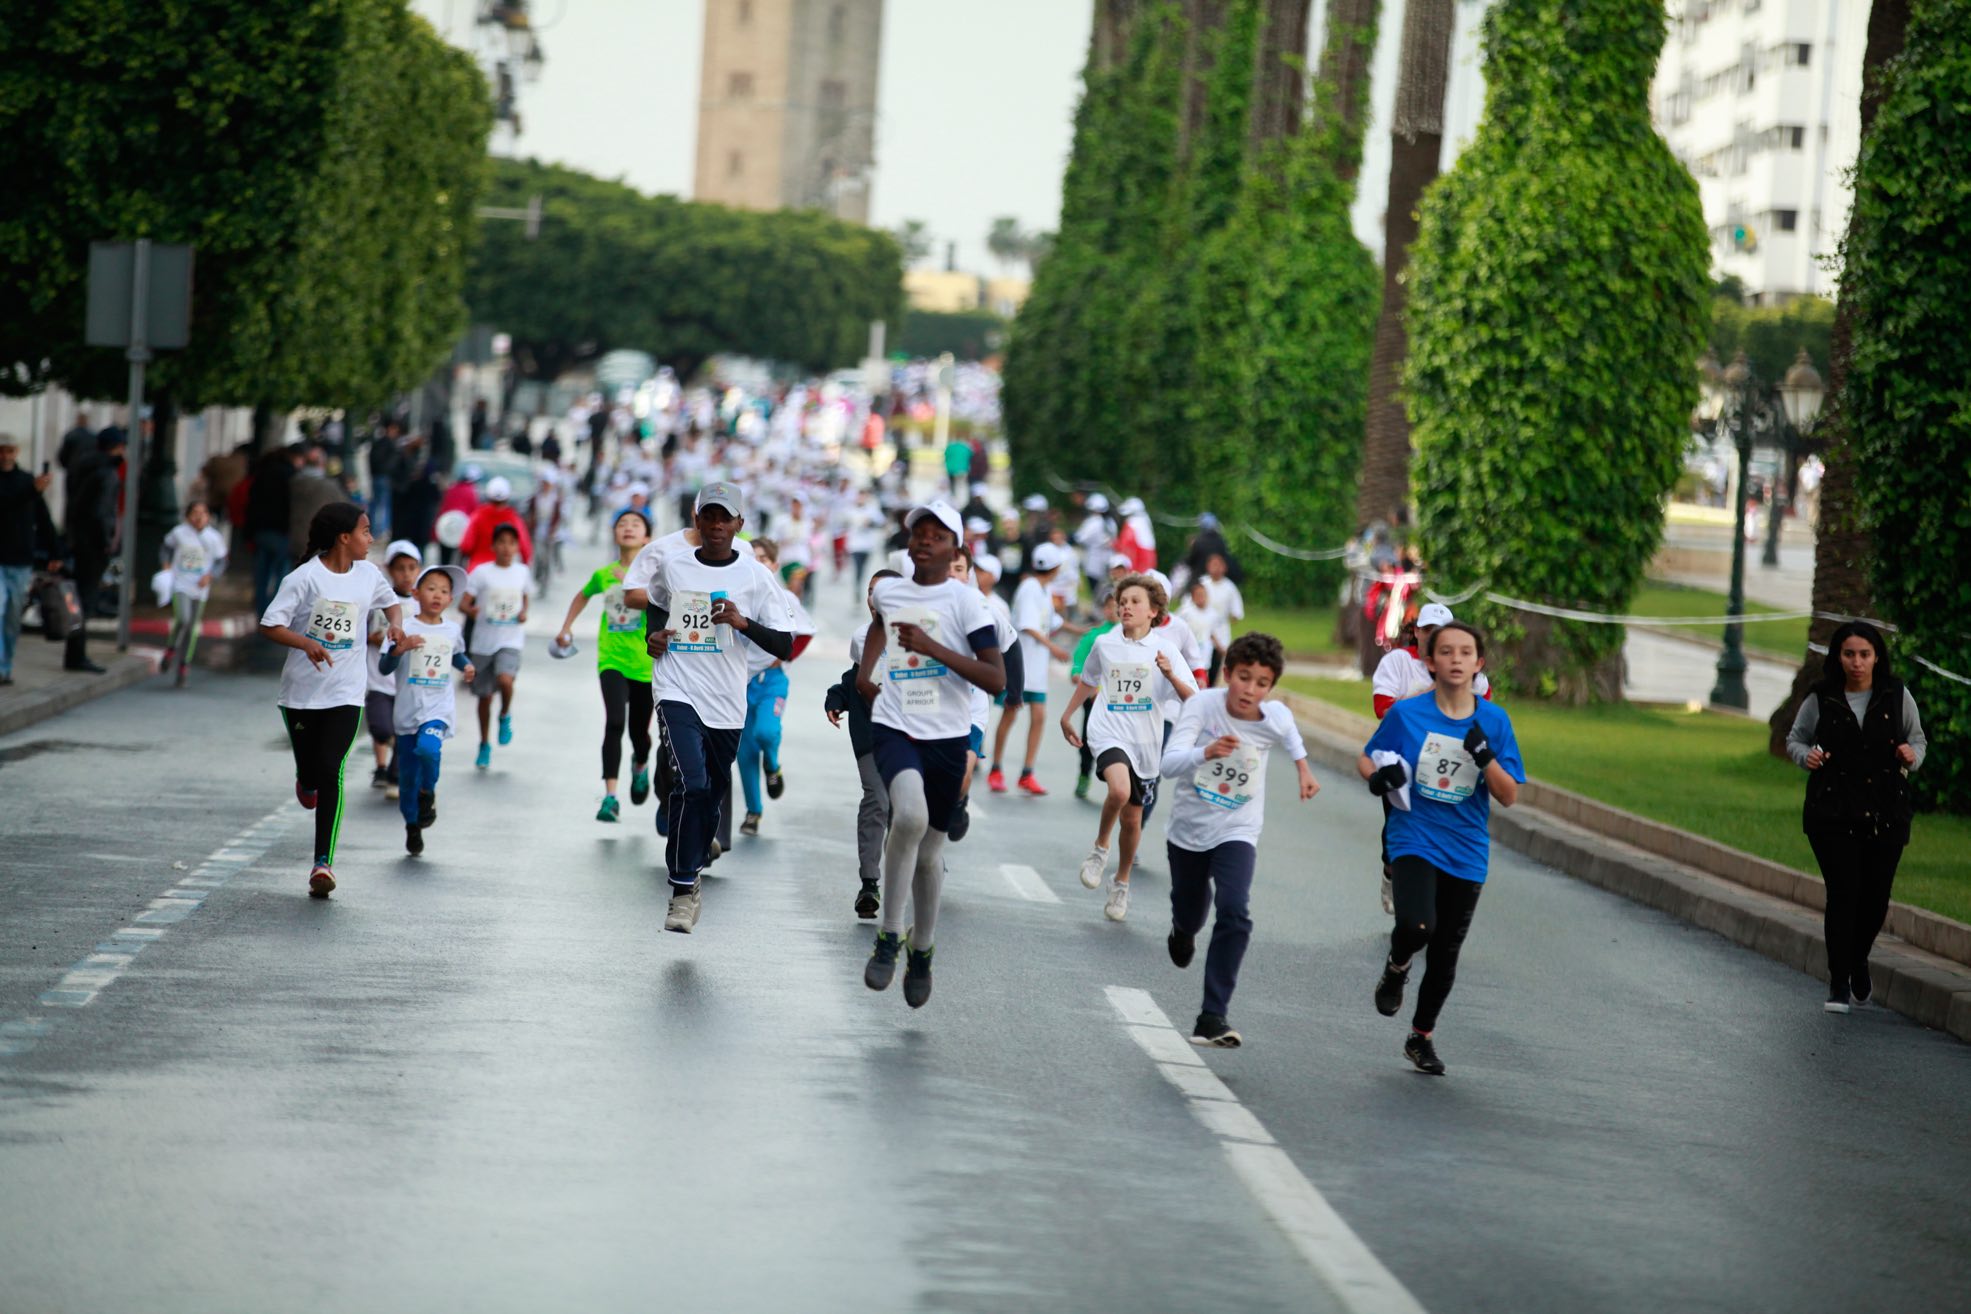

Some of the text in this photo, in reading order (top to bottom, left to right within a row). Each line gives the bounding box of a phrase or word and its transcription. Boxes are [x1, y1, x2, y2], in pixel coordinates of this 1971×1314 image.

[314, 614, 352, 632] 2263
[682, 614, 709, 629] 912
[424, 655, 441, 667] 72
[1117, 680, 1142, 692] 179
[906, 690, 933, 698] GROUPE
[1212, 762, 1249, 787] 399
[1436, 759, 1462, 777] 87
